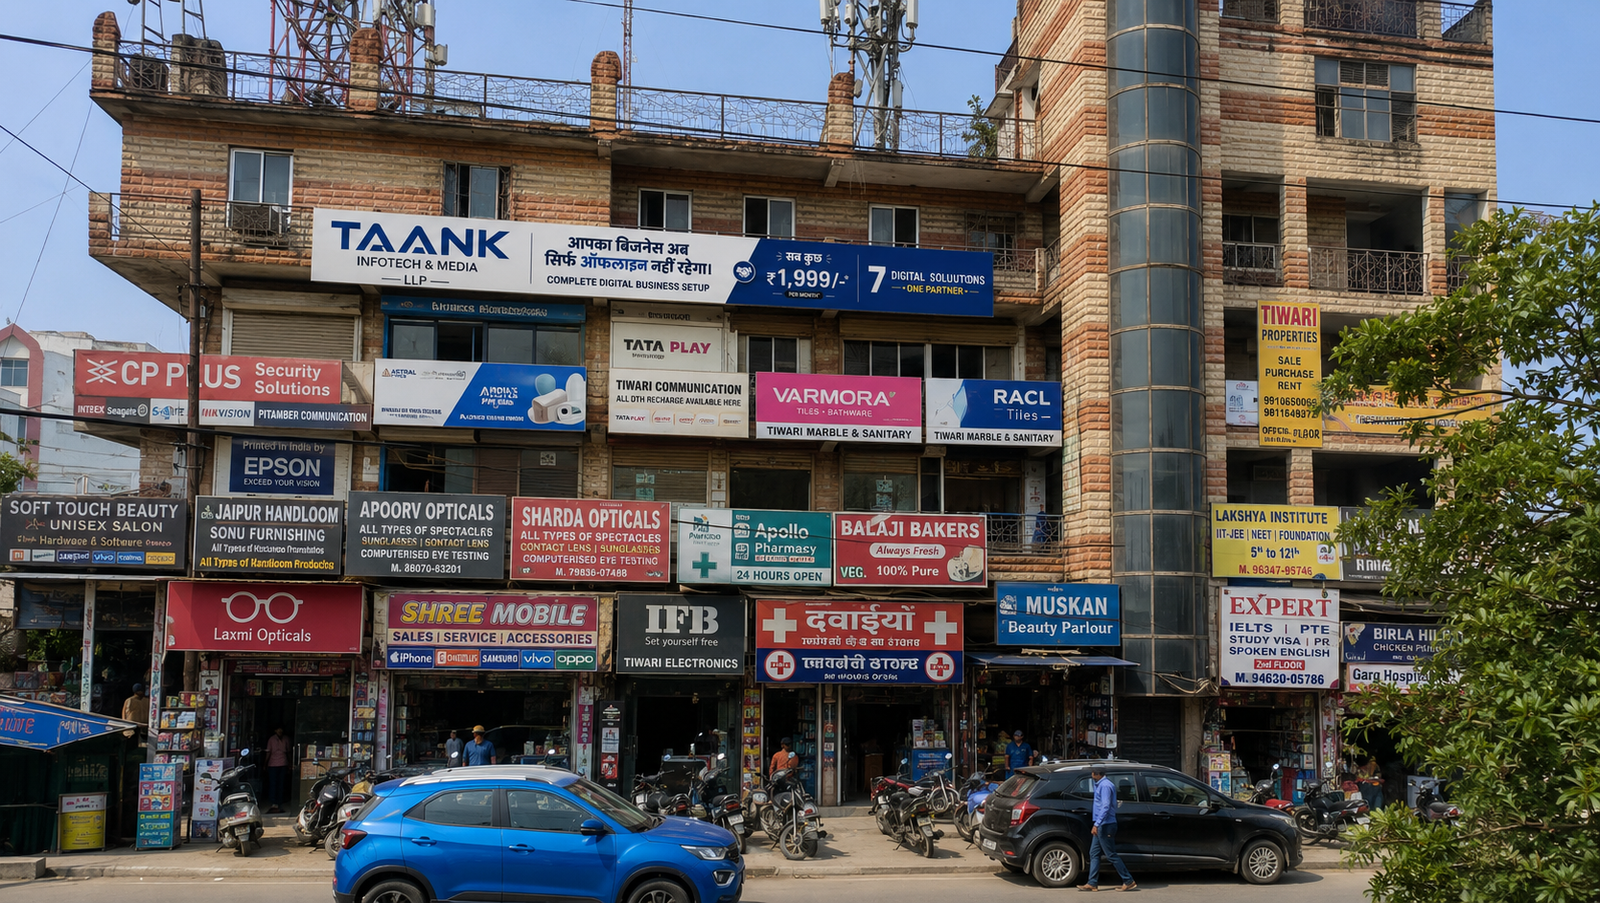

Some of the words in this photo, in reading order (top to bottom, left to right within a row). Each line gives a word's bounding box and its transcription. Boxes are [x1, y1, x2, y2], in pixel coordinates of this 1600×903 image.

[331, 221, 510, 259] TAANK
[568, 237, 612, 251] आपका
[616, 236, 664, 254] बिजनेस
[357, 256, 420, 270] INFOTECH
[425, 260, 434, 270] &
[437, 260, 478, 272] MEDIA
[544, 250, 576, 266] सिर्फ
[580, 252, 648, 272] ऑफलाइन
[651, 257, 676, 274] नहीं
[804, 253, 822, 266] कुछ
[404, 274, 426, 286] LLP
[547, 276, 597, 286] COMPLETE
[600, 278, 633, 288] DIGITAL
[636, 280, 680, 290] BUSINESS
[682, 282, 710, 292] SETUP
[868, 266, 886, 293] 7
[891, 270, 926, 282] DIGITAL
[906, 284, 924, 293] ONE
[926, 285, 964, 295] PARTNER
[1261, 305, 1317, 327] TIWARI
[1262, 330, 1318, 343] PROPERTIES
[624, 339, 664, 352] TATA
[670, 342, 711, 354] PLAY
[1278, 356, 1301, 366] SALE
[122, 360, 159, 386] CP
[255, 362, 320, 382] Security
[1266, 368, 1314, 378] PURCHASE
[255, 380, 330, 396] Solutions
[616, 380, 652, 391] TIWARI
[656, 382, 742, 394] COMMUNICATION
[1278, 382, 1302, 390] RENT
[646, 396, 684, 404] RECHARGE
[686, 397, 722, 406] AVAILABLE
[724, 398, 742, 406] HERE
[772, 388, 890, 406] VARMORA
[994, 389, 1050, 406] RACL
[258, 409, 298, 420] PITAMBER
[301, 410, 367, 422] COMMUNICATION
[797, 408, 820, 416] TILES
[828, 408, 872, 418] BATHWARE
[1006, 408, 1038, 420] Tiles
[767, 426, 802, 436] TIWARI
[806, 428, 848, 438] MARBLE
[852, 428, 859, 438] &
[862, 429, 912, 440] SANITARY
[934, 432, 964, 440] TIWARI
[1013, 434, 1054, 442] SANITARY
[242, 440, 276, 450] Printed
[290, 442, 311, 452] India
[314, 444, 326, 454] by
[244, 457, 320, 476] EPSON
[10, 500, 50, 515] SOFT
[56, 502, 110, 516] TOUCH
[117, 504, 178, 518] BEAUTY
[216, 504, 262, 520] JAIPUR
[266, 505, 338, 523] HANDLOOM
[360, 500, 422, 520] APOORV
[425, 502, 494, 521] OPTICALS
[522, 506, 584, 528] SHARDA
[588, 508, 660, 530] OPTICALS
[1216, 510, 1266, 522] LAKSHYA
[1270, 512, 1328, 524] INSTITUTE
[50, 520, 107, 531] UNISEX
[112, 521, 162, 532] SALON
[360, 524, 378, 534] ALL
[382, 525, 412, 535] TYPES
[414, 526, 428, 535] OF
[754, 523, 808, 542] Apollo
[841, 520, 904, 537] BALAJI
[910, 522, 980, 538] BAKERS
[210, 526, 245, 540] SONU
[250, 528, 325, 542] FURNISHING
[520, 531, 540, 540] ALL
[543, 531, 576, 541] TYPES
[579, 532, 592, 541] OF
[595, 533, 661, 543] SPECTACLES
[1216, 529, 1244, 539] IIT-JEE
[1252, 530, 1272, 540] NEET
[1280, 530, 1330, 541] FOUNDATION
[467, 539, 490, 548] LENS
[520, 542, 564, 552] CONTACT
[568, 544, 592, 552] LENS
[755, 543, 817, 556] Pharmacy
[360, 549, 430, 559] COMPUTERISED
[432, 550, 449, 560] EYE
[452, 550, 490, 560] TESTING
[876, 546, 910, 557] Always
[913, 546, 939, 556] Fresh
[1266, 548, 1276, 558] to
[523, 554, 596, 564] COMPUTERISED
[600, 556, 616, 564] EYE
[391, 564, 402, 572] M.
[556, 568, 566, 576] M.
[840, 566, 867, 578] VEG.
[876, 566, 908, 576] 100%
[912, 566, 939, 576] Pure
[1238, 565, 1250, 574] M.
[736, 570, 750, 580] 24
[754, 571, 790, 580] HOURS
[794, 572, 822, 582] OPEN
[1026, 596, 1108, 615] MUSKAN
[1230, 594, 1332, 617] EXPERT
[401, 600, 487, 624] SHREE
[490, 602, 588, 626] MOBILE
[645, 604, 719, 634] IFB
[1008, 621, 1058, 636] Beauty
[1062, 621, 1113, 634] Parlour
[1230, 622, 1273, 632] IELTS
[1300, 624, 1330, 634] PTE
[1374, 628, 1414, 641] BIRLA
[214, 628, 252, 641] Laxmi
[257, 628, 311, 644] Opticals
[393, 632, 433, 642] SALES
[444, 632, 496, 643] SERVICE
[506, 632, 592, 644] ACCESSORIES
[645, 637, 660, 646] Set
[662, 637, 698, 648] yourself
[701, 638, 718, 646] free
[1230, 635, 1270, 644] STUDY
[1274, 636, 1301, 645] VISA
[1314, 638, 1330, 646] PR
[400, 652, 432, 663] iPhone
[524, 653, 552, 663] vivo
[1230, 647, 1276, 656] SPOKEN
[1280, 648, 1330, 657] ENGLISH
[558, 655, 594, 666] oppo
[624, 658, 662, 668] TIWARI
[665, 658, 738, 668] ELECTRONICS
[1274, 661, 1302, 669] FLOOR
[1236, 672, 1248, 683] M.
